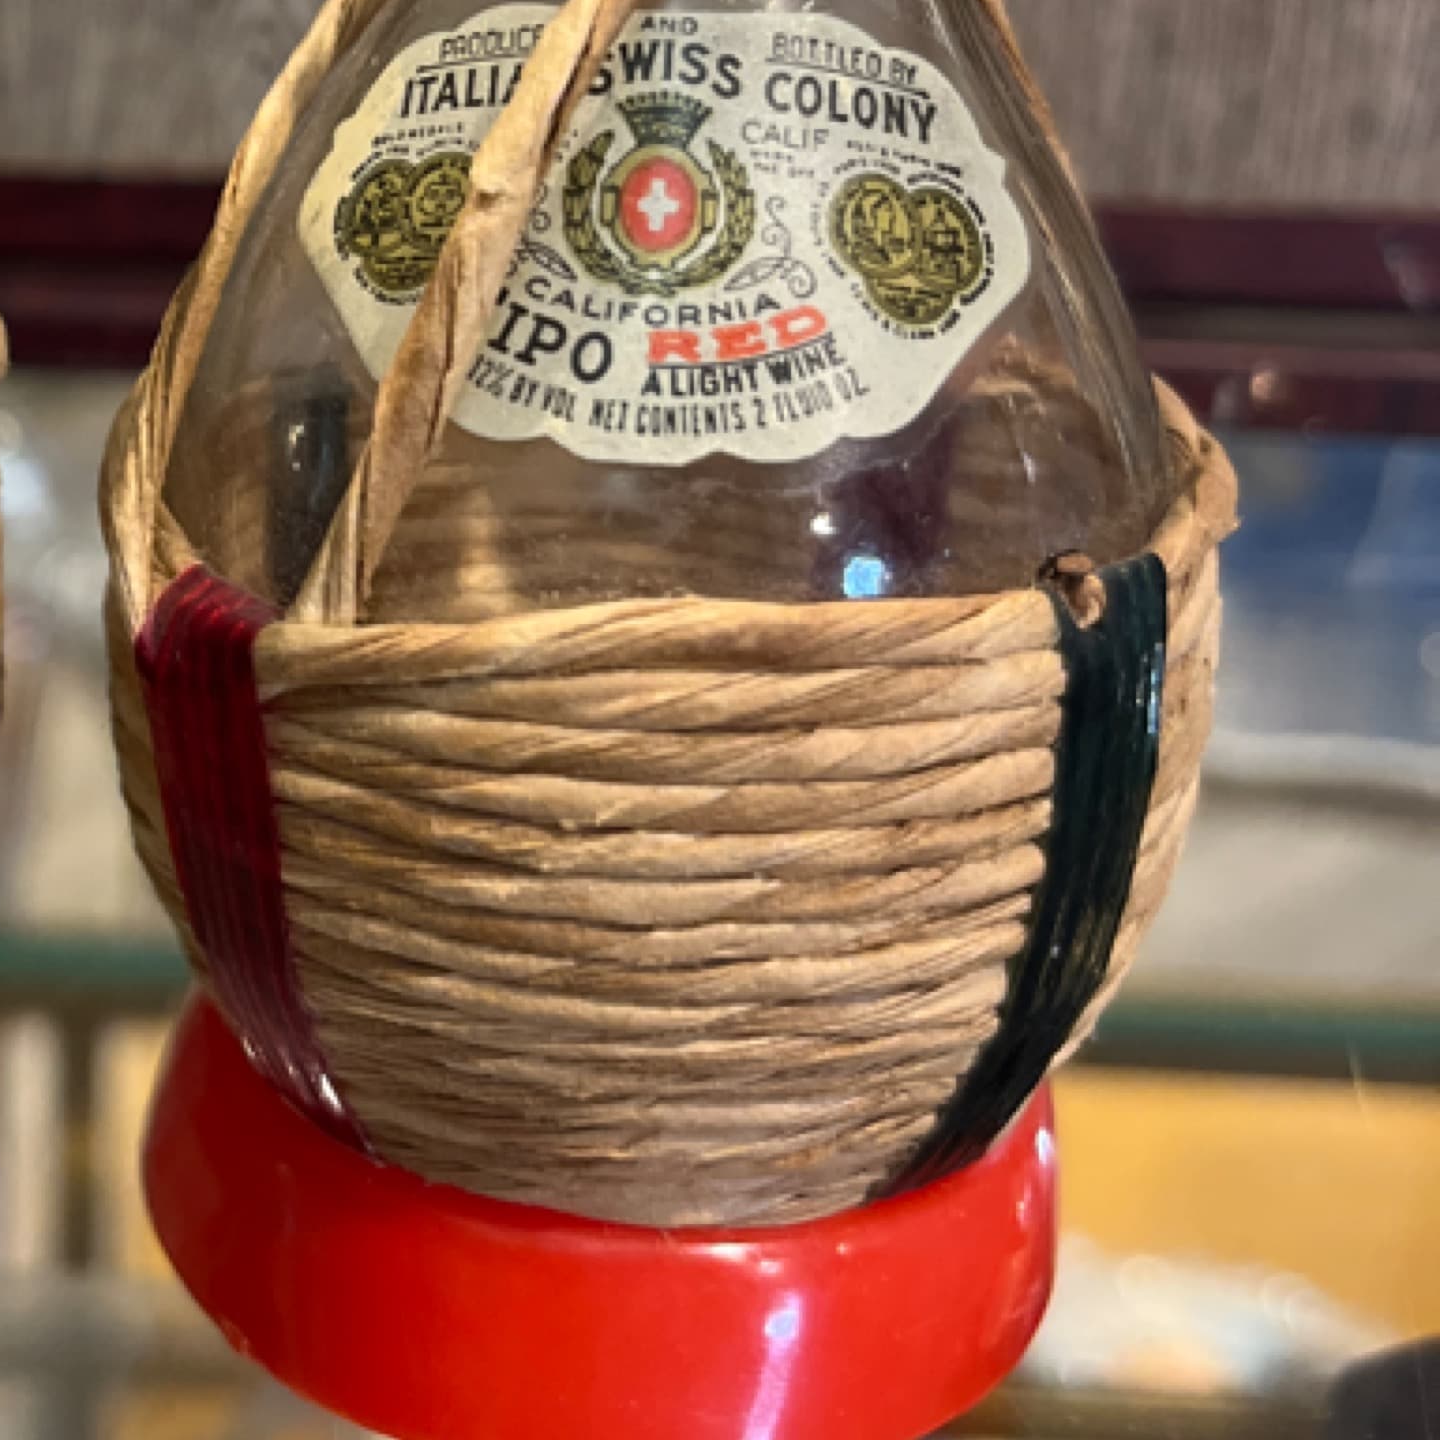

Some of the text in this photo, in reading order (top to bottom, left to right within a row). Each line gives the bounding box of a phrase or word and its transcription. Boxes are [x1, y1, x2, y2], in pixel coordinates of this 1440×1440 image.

[439, 24, 545, 59] PRODUCE
[641, 16, 698, 35] AND
[772, 32, 918, 85] BOTTLED BY
[765, 73, 937, 145] COLONY
[525, 275, 781, 326] CALIFORNIA
[487, 287, 613, 384] IPO
[647, 305, 827, 364] RED
[509, 373, 540, 408] BY
[589, 398, 630, 432] NET
[635, 401, 747, 437] CONTENTS
[753, 397, 767, 430] 2
[641, 366, 663, 396] A
[670, 363, 759, 397] LIGHT
